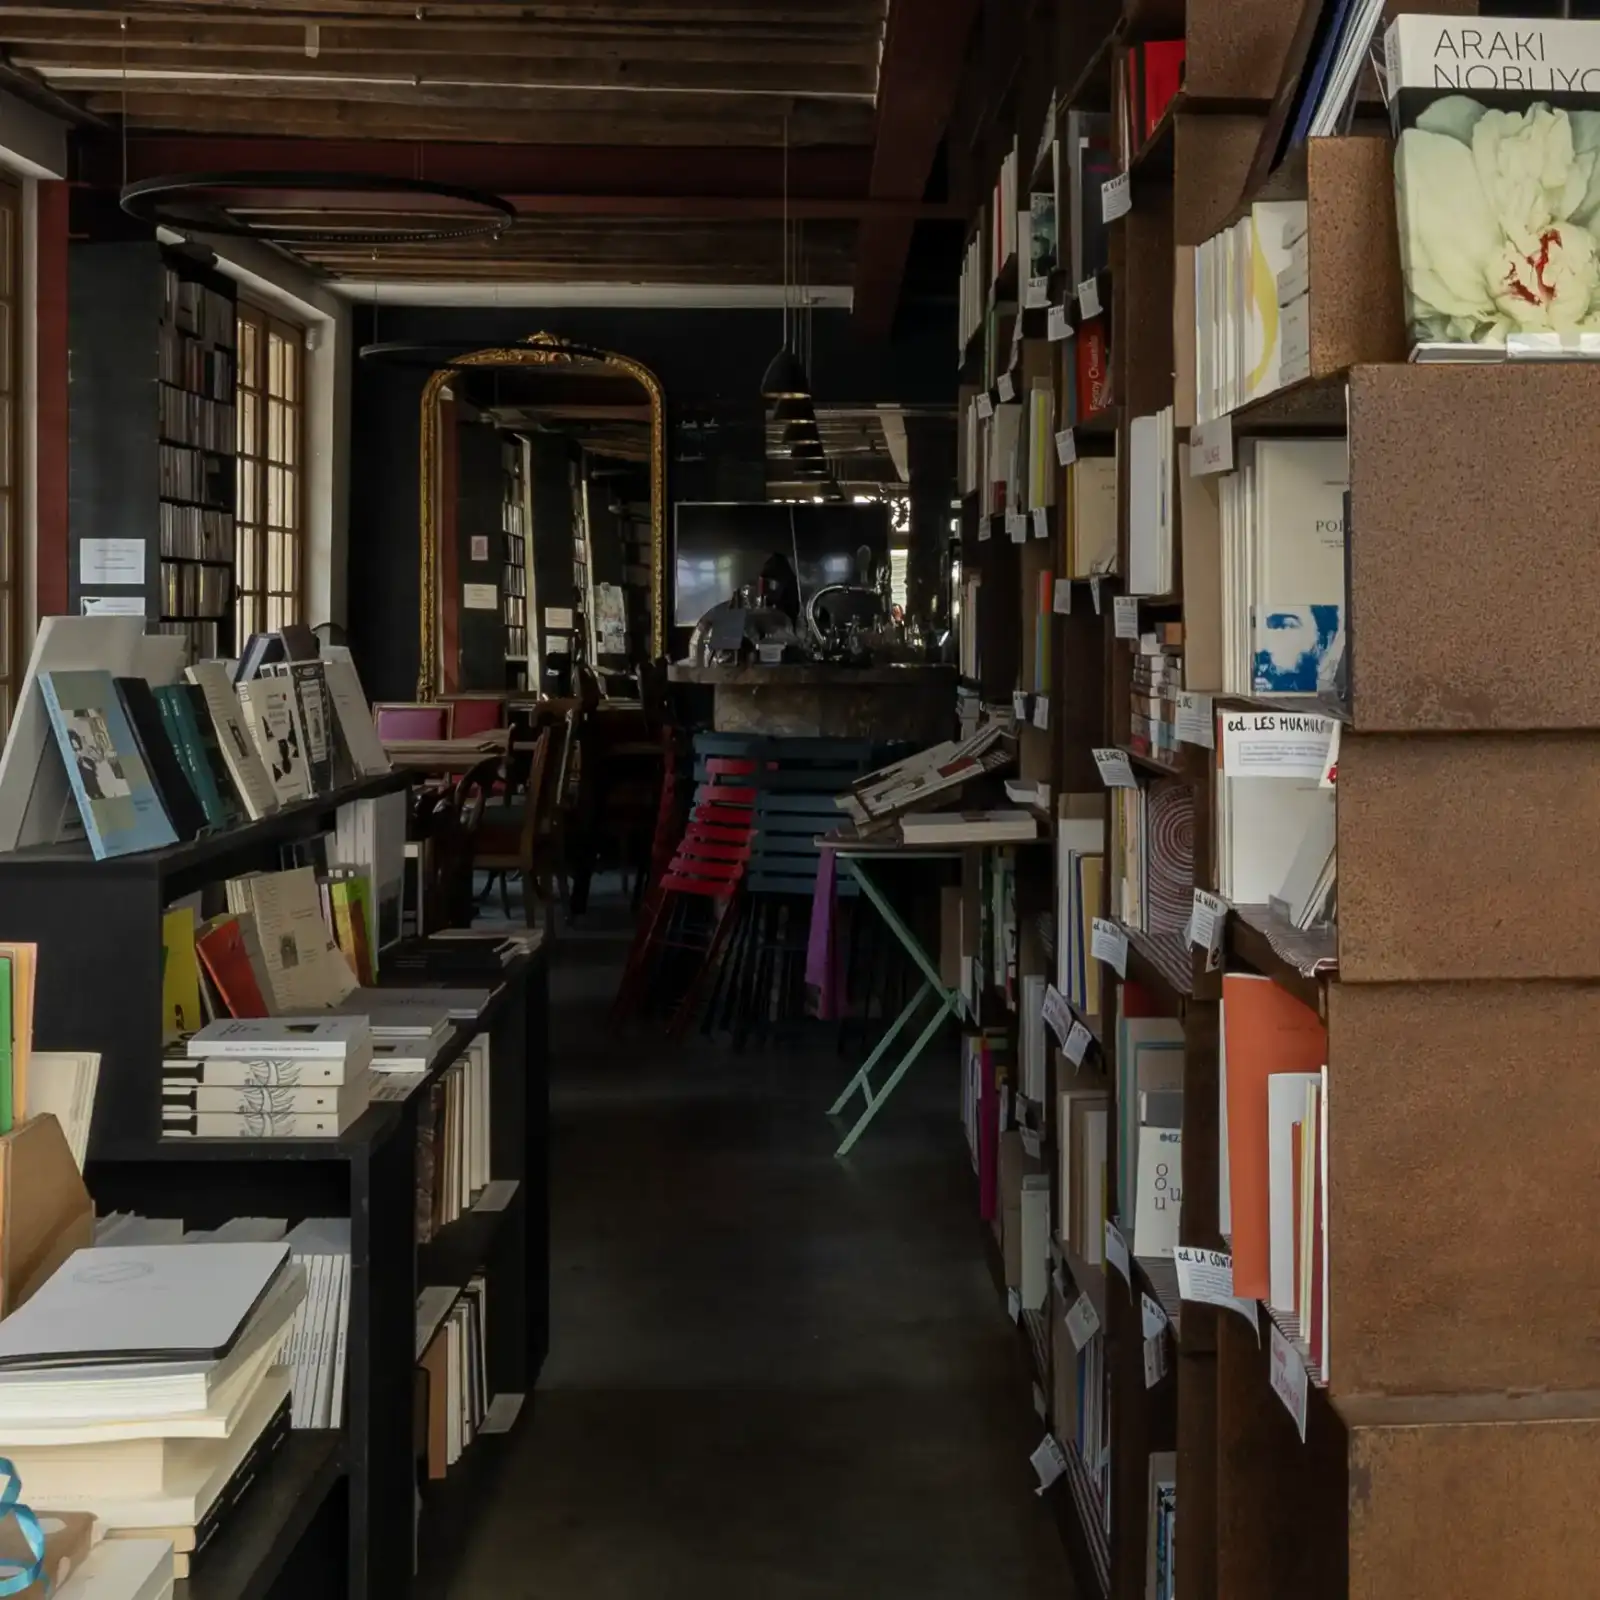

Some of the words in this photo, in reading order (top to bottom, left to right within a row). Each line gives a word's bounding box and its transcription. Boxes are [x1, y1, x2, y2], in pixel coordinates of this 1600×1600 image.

[1434, 29, 1545, 61] ARAKI
[1254, 716, 1275, 731] LES
[1194, 1251, 1206, 1264] LA
